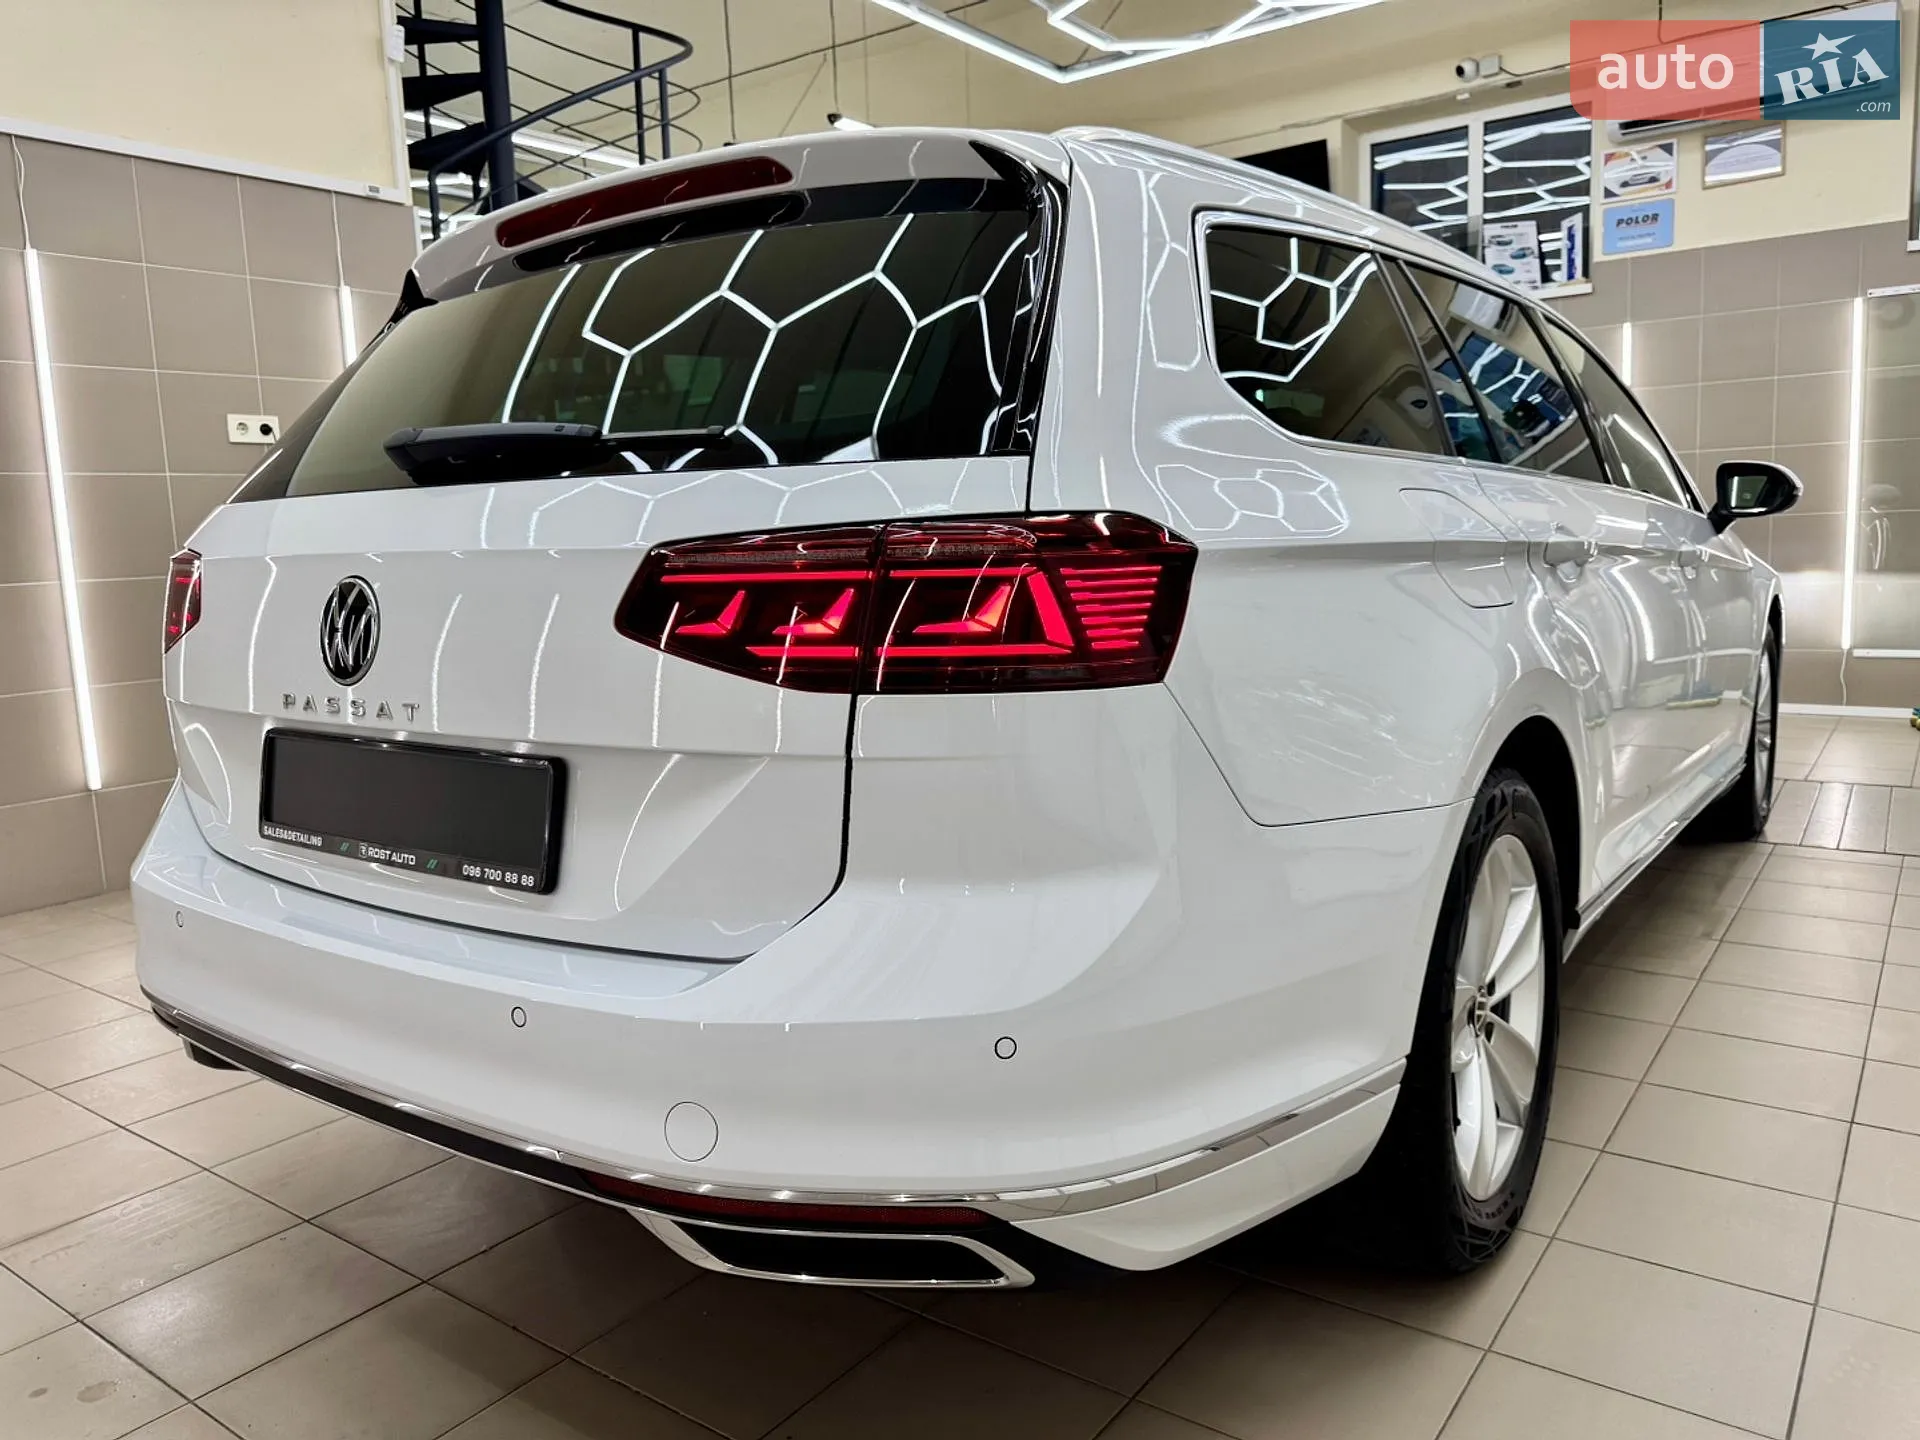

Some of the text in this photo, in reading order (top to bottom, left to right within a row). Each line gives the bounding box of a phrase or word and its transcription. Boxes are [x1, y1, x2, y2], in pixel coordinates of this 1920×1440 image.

[1615, 213, 1660, 228] POLOR
[282, 693, 420, 722] PASSAT
[263, 825, 323, 847] SALES&DETAILING
[367, 846, 416, 866] ROST AUTO
[462, 864, 535, 887] 096 700 88 88
